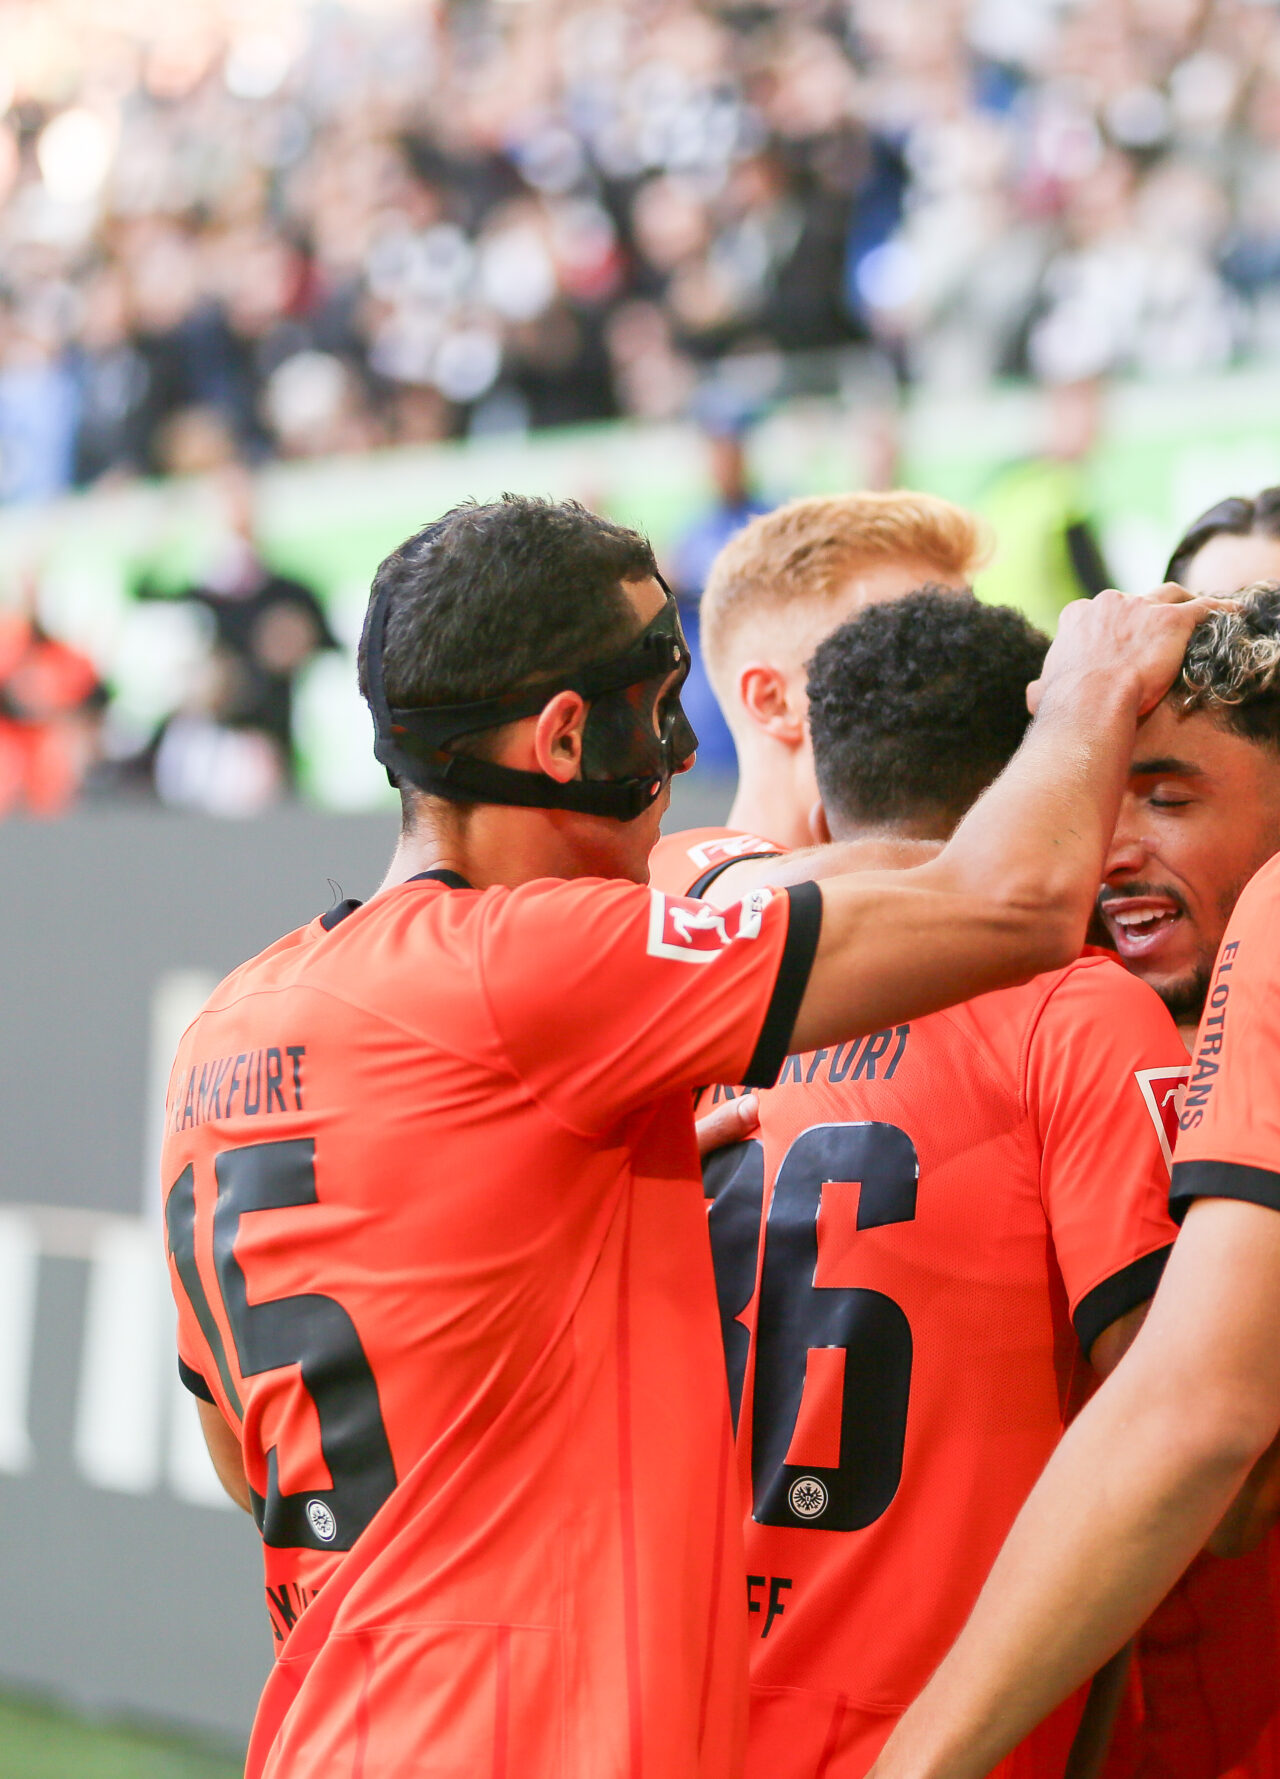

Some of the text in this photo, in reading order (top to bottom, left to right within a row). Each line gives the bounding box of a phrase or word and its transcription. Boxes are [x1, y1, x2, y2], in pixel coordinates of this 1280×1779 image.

[168, 1045, 306, 1136] ANKFURT
[1179, 940, 1240, 1131] ELOTRANS
[166, 1137, 399, 1552] 15
